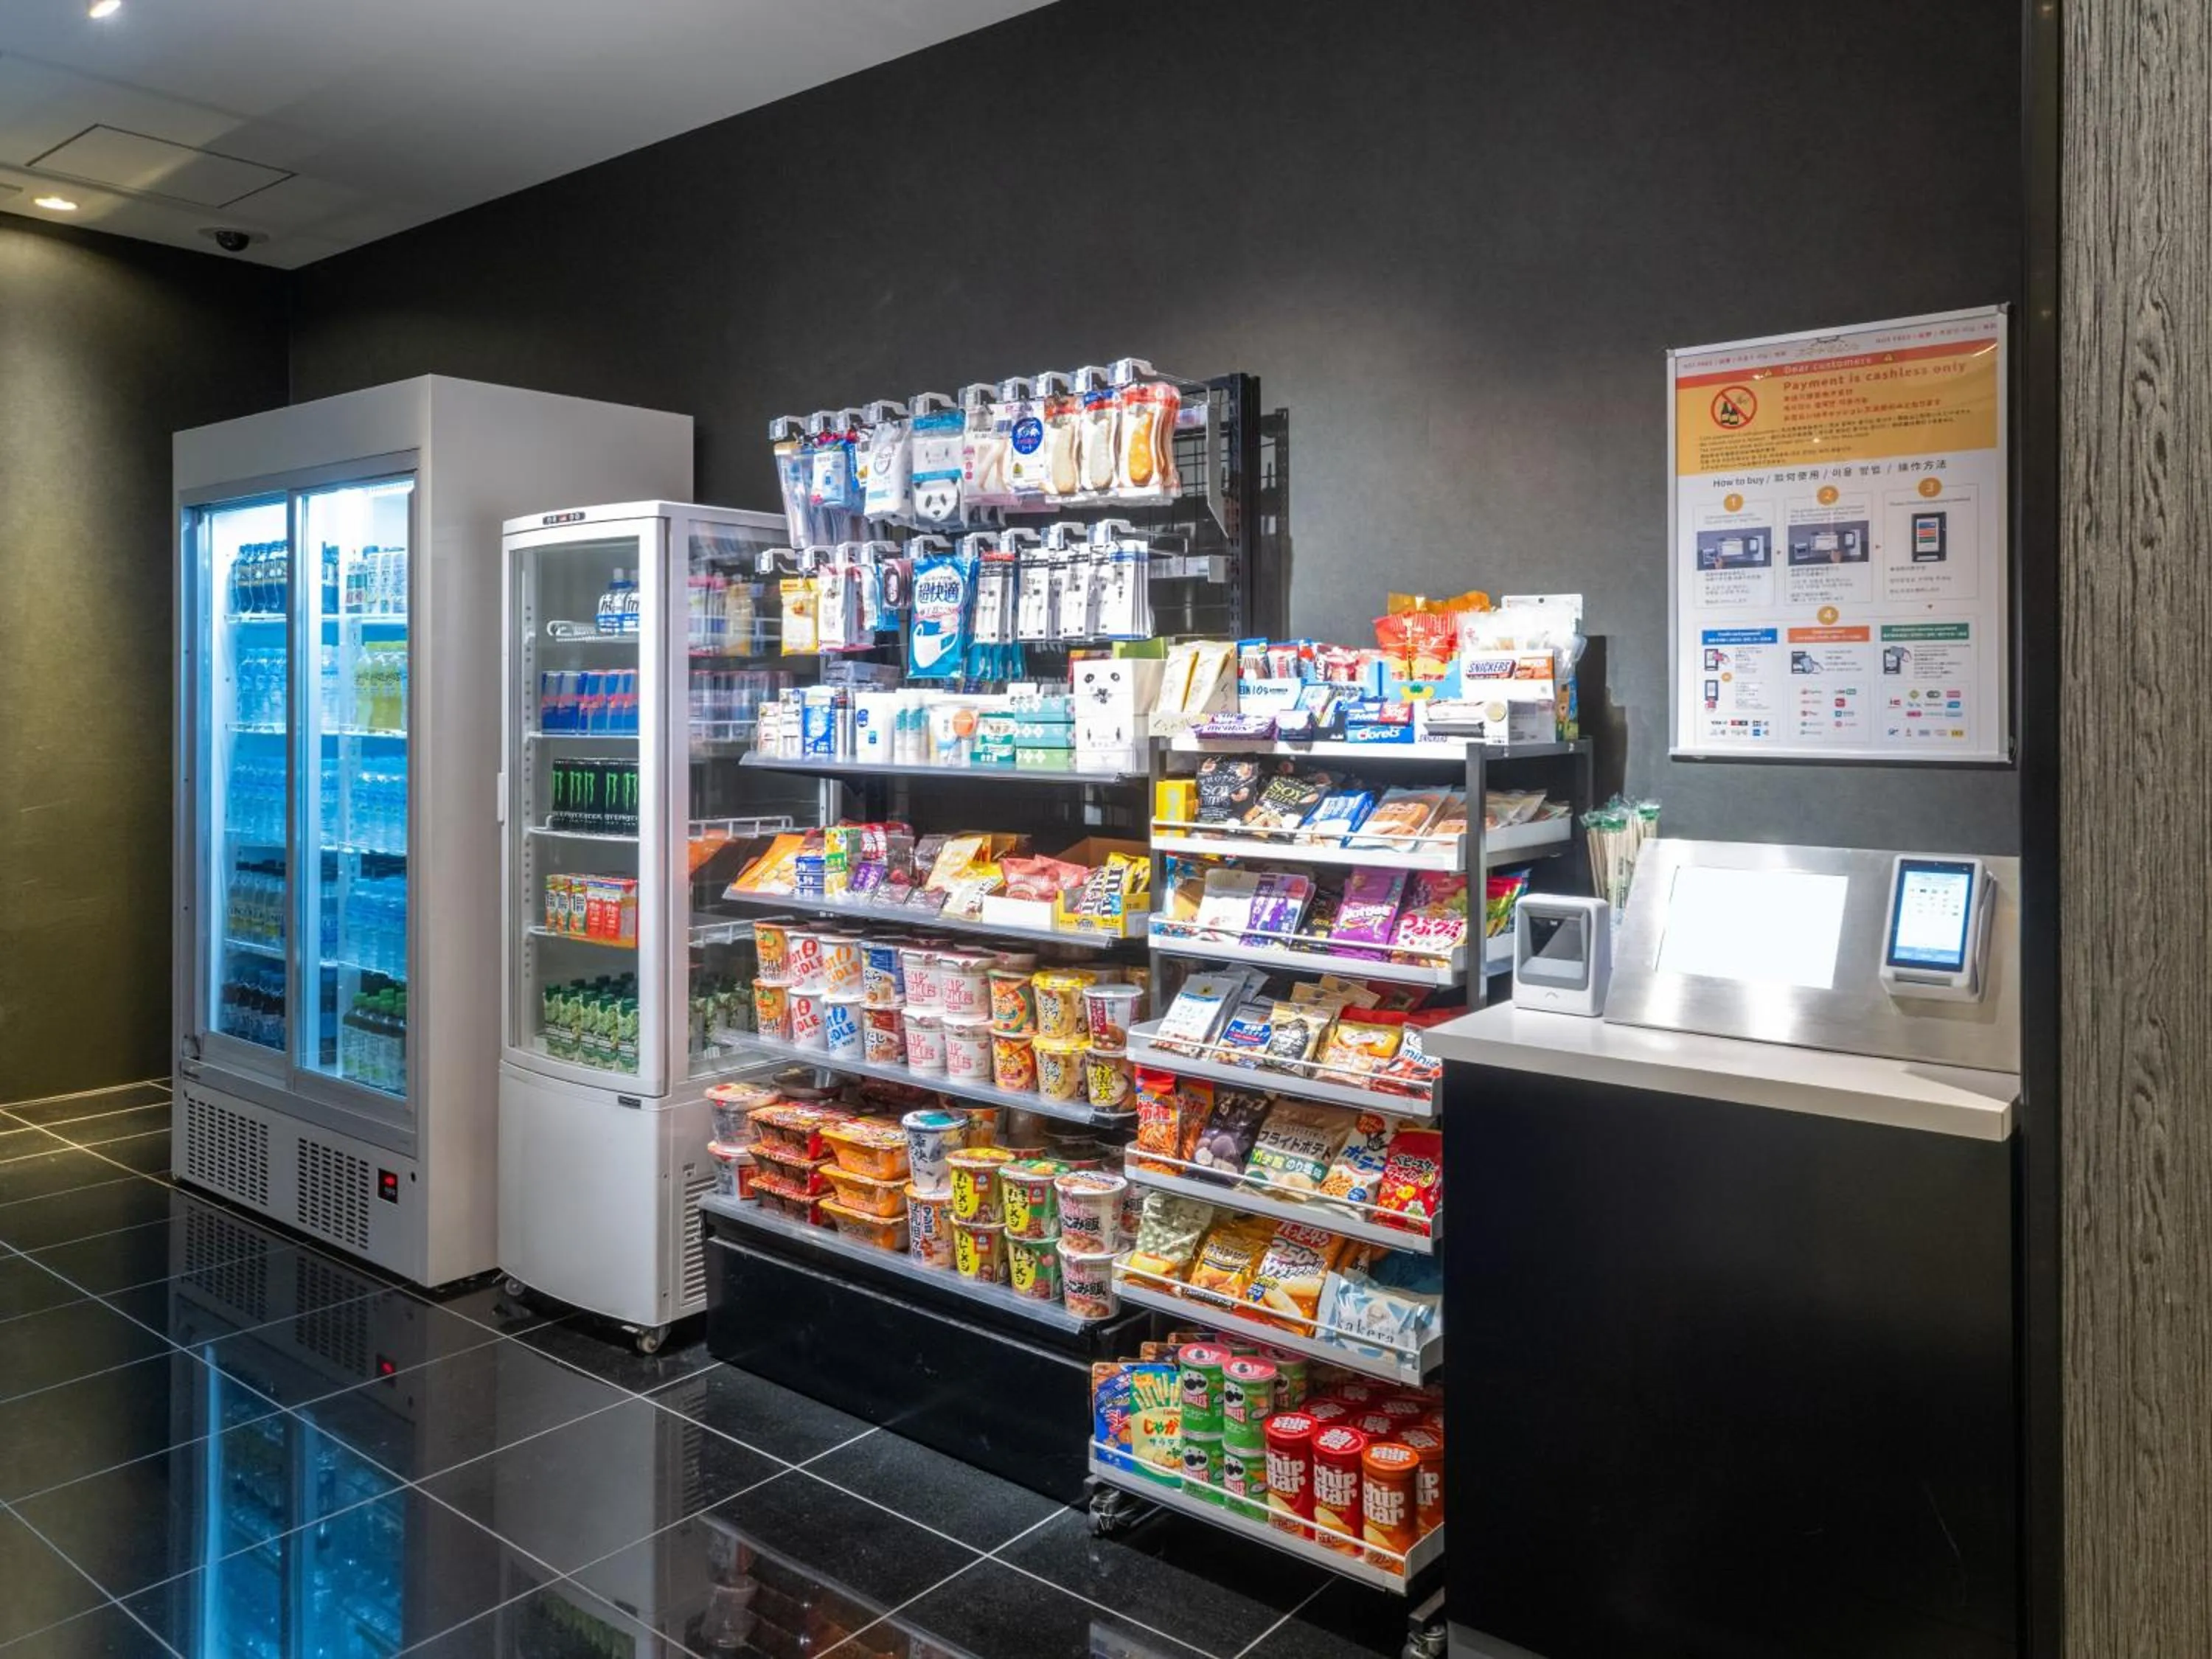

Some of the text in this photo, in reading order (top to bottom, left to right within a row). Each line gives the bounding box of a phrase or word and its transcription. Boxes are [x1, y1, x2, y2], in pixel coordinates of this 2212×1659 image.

[1783, 361, 1967, 391] Payment is cashless only
[1713, 478, 1733, 487] How
[1735, 477, 1745, 486] to
[1747, 475, 1764, 487] buy
[919, 580, 959, 604] 超快適
[1469, 661, 1511, 673] SNICKERS
[1274, 780, 1302, 801] SOY
[1337, 1311, 1394, 1344] kakera
[1143, 1416, 1180, 1435] じゃが
[1313, 1463, 1357, 1490] chip
[1416, 1464, 1439, 1489] ip
[1313, 1481, 1357, 1506] star
